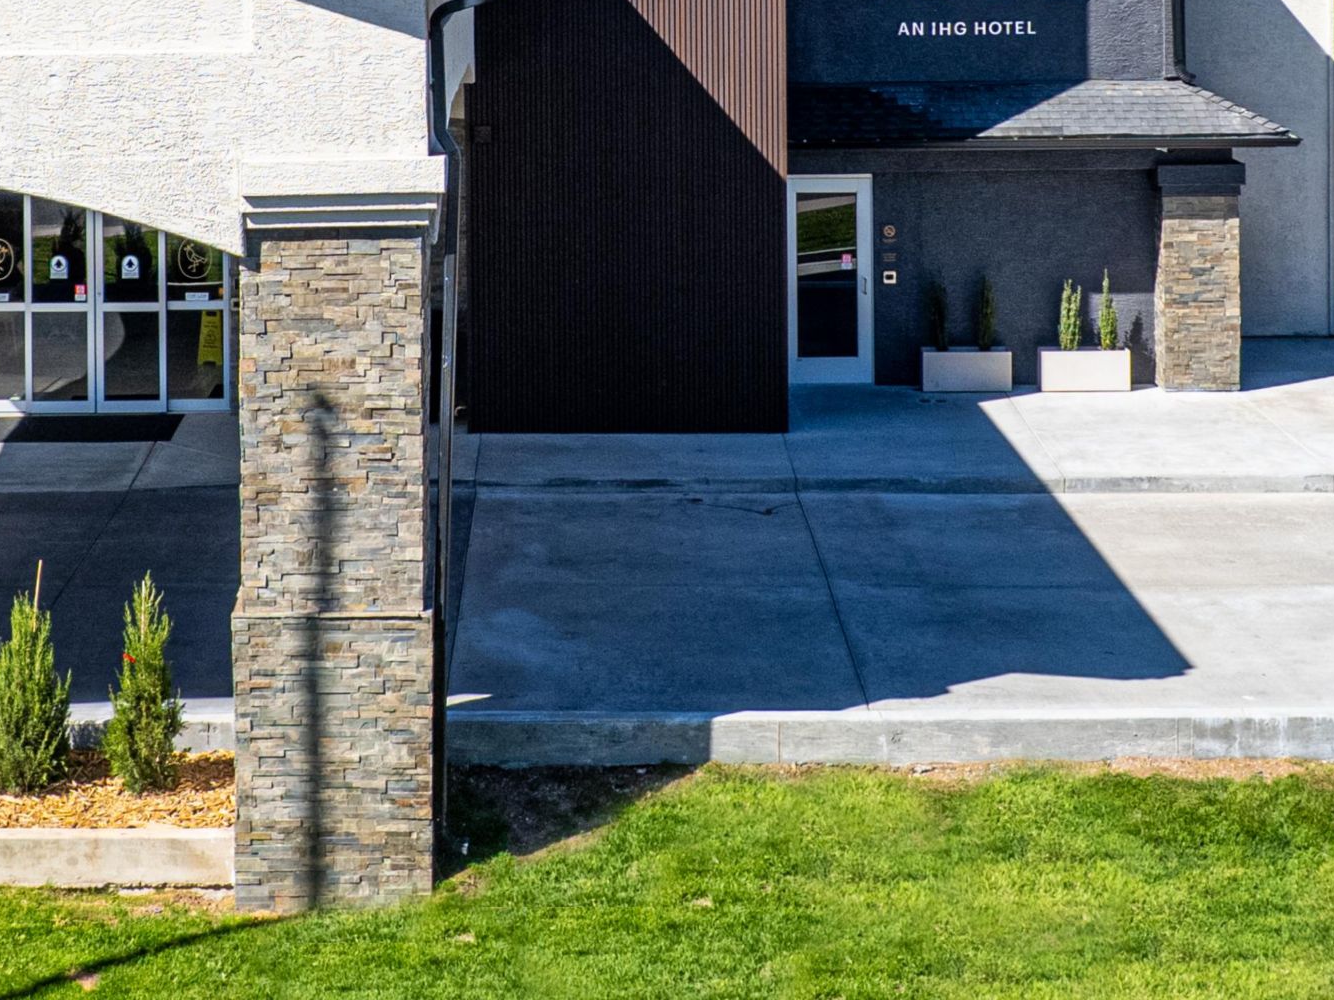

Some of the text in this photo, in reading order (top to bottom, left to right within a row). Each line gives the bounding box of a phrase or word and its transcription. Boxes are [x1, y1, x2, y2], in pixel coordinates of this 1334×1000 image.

[898, 20, 1037, 36] AN IHG HOTEL
